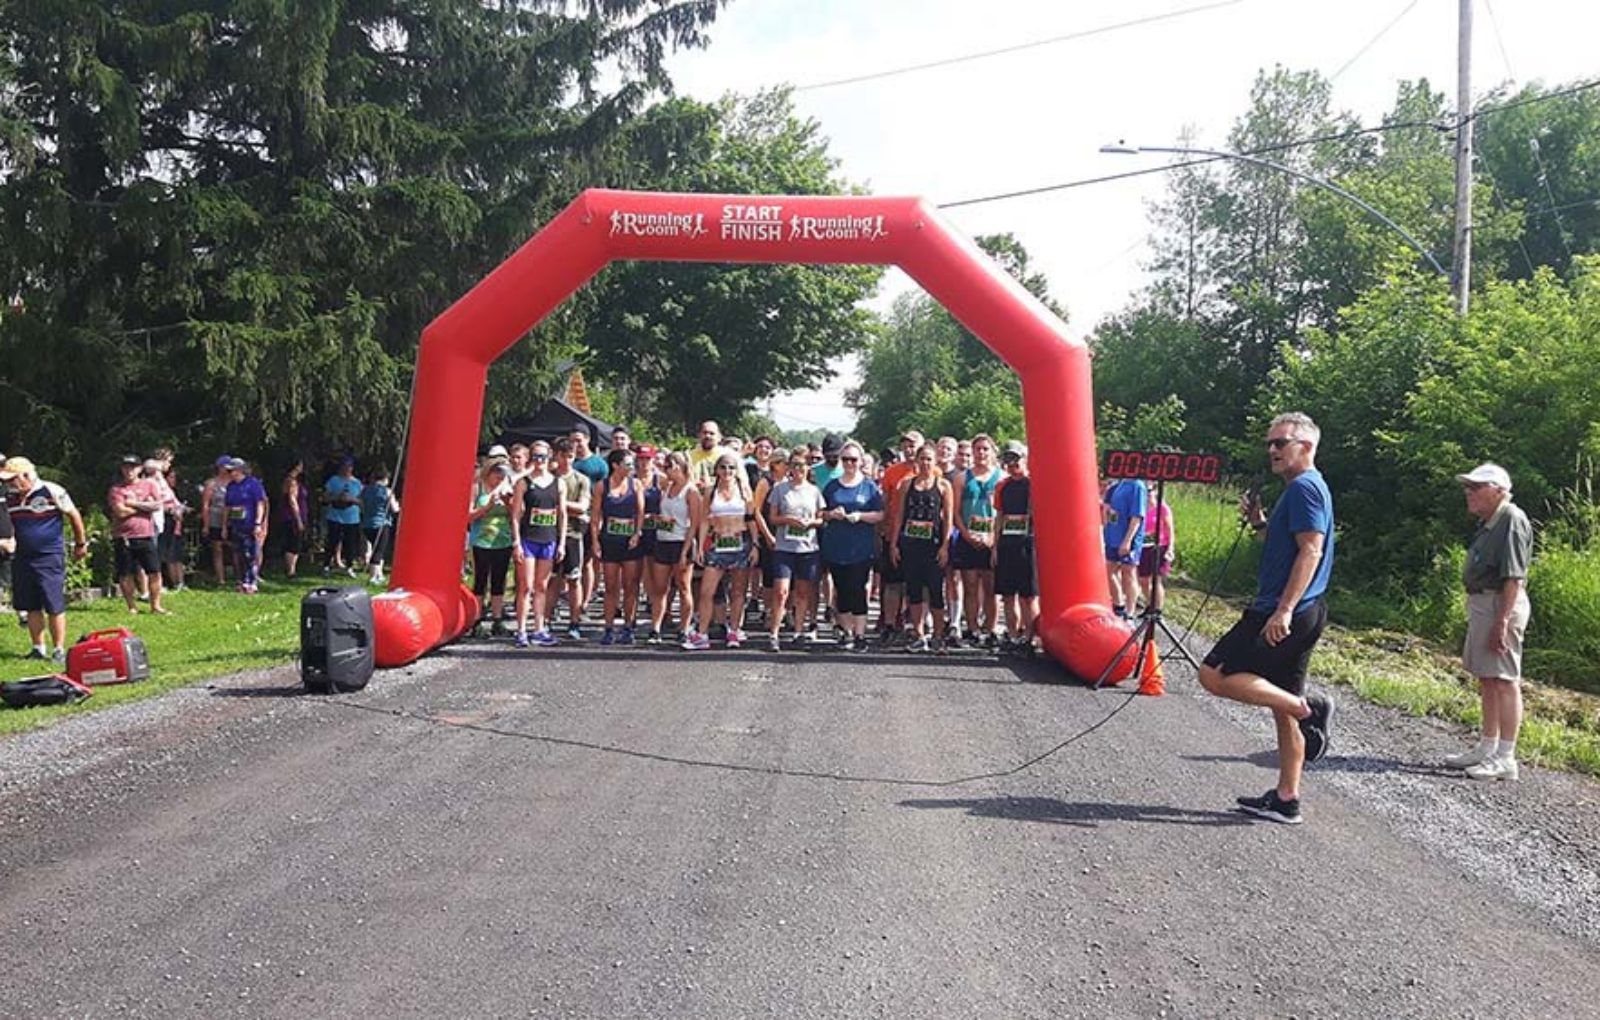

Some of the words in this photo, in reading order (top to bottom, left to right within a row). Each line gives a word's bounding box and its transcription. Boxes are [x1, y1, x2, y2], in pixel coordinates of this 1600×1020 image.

[721, 204, 783, 220] START
[622, 211, 692, 236] Running
[721, 224, 782, 241] FINISH
[801, 214, 874, 239] Running
